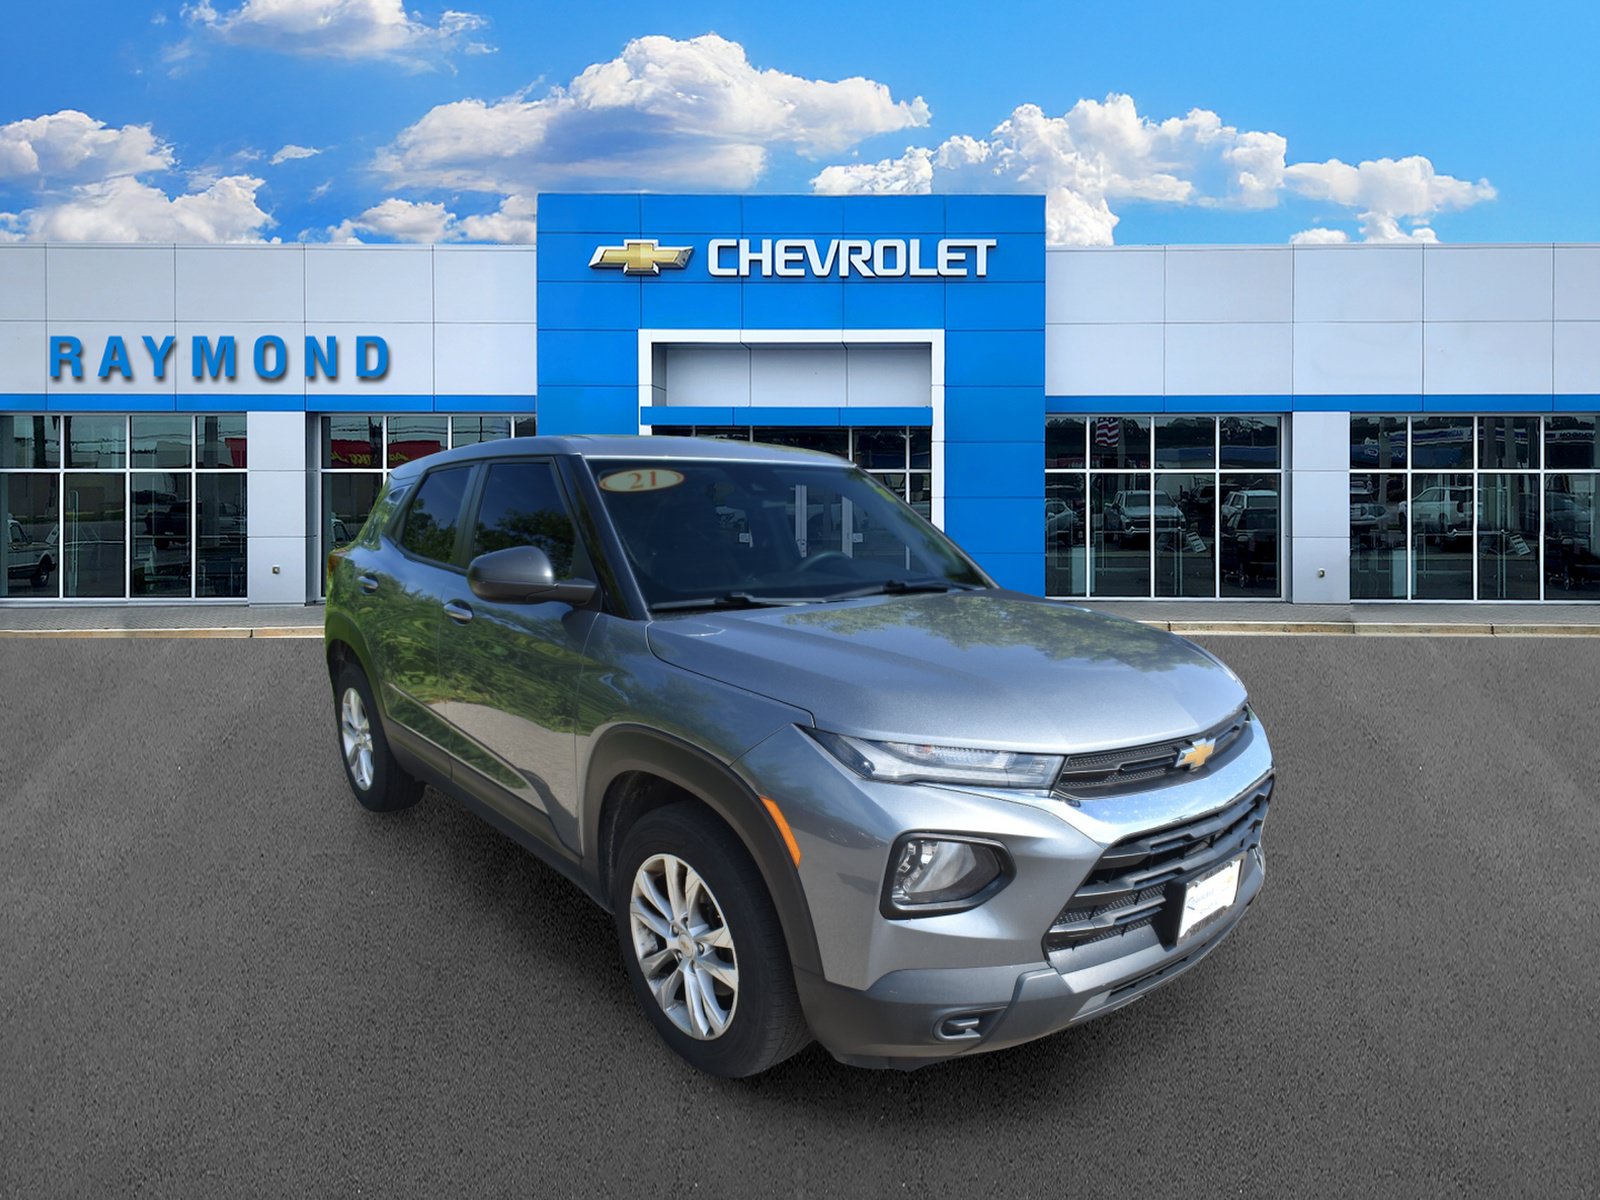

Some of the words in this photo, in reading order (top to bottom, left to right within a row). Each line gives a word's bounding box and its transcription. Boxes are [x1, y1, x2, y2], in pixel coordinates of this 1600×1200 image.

[707, 239, 997, 277] CHEVROLET
[49, 335, 390, 379] RAYMOND
[628, 470, 657, 490] 21
